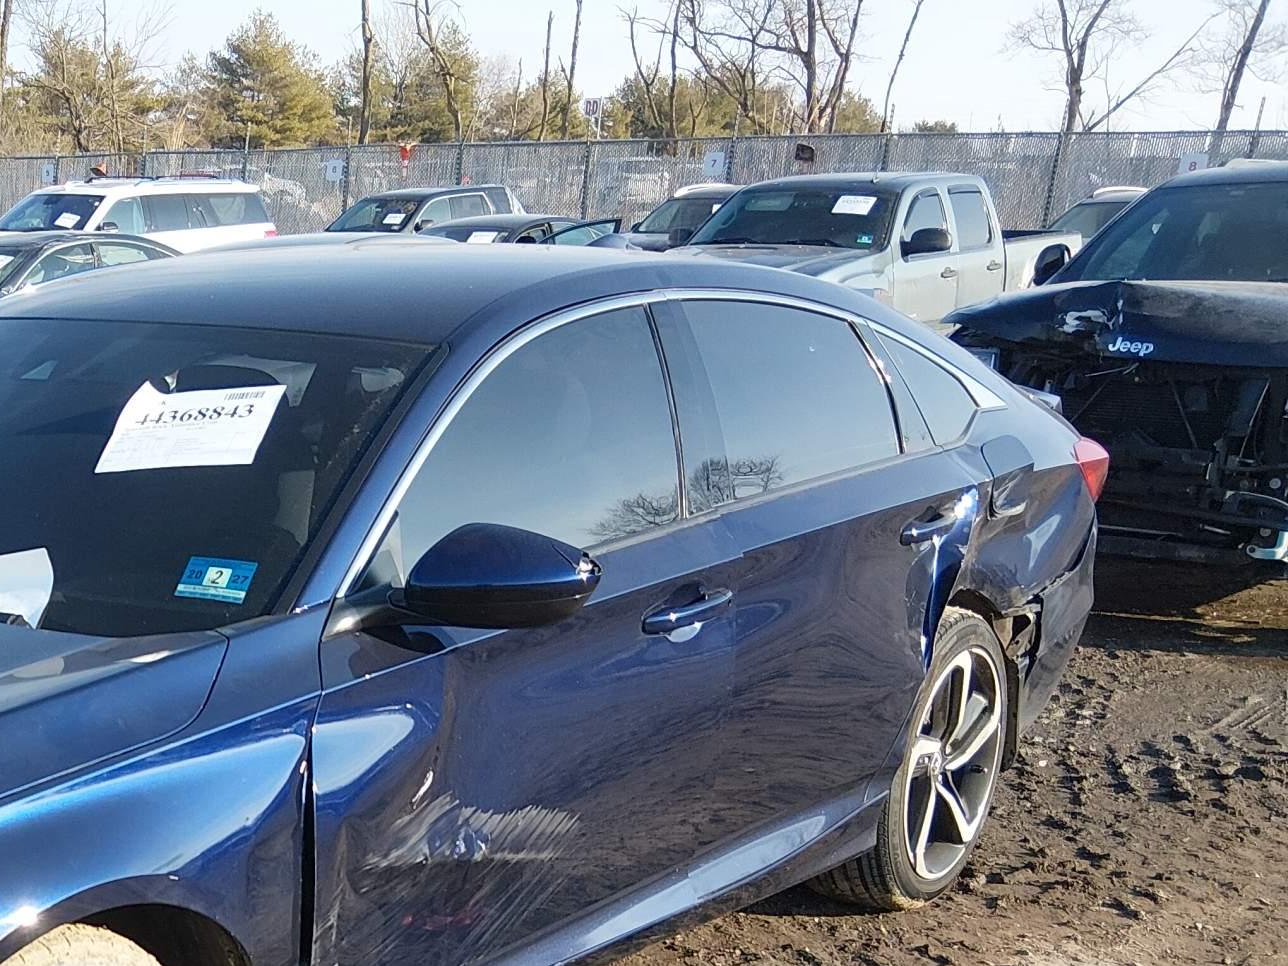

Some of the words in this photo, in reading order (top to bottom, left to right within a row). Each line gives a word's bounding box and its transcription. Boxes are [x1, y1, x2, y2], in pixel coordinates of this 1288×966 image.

[1188, 161, 1197, 172] 8
[1108, 336, 1154, 357] Jeep
[136, 403, 254, 426] 44368843
[187, 569, 203, 580] 20
[211, 569, 224, 585] 2
[232, 574, 250, 585] 27
